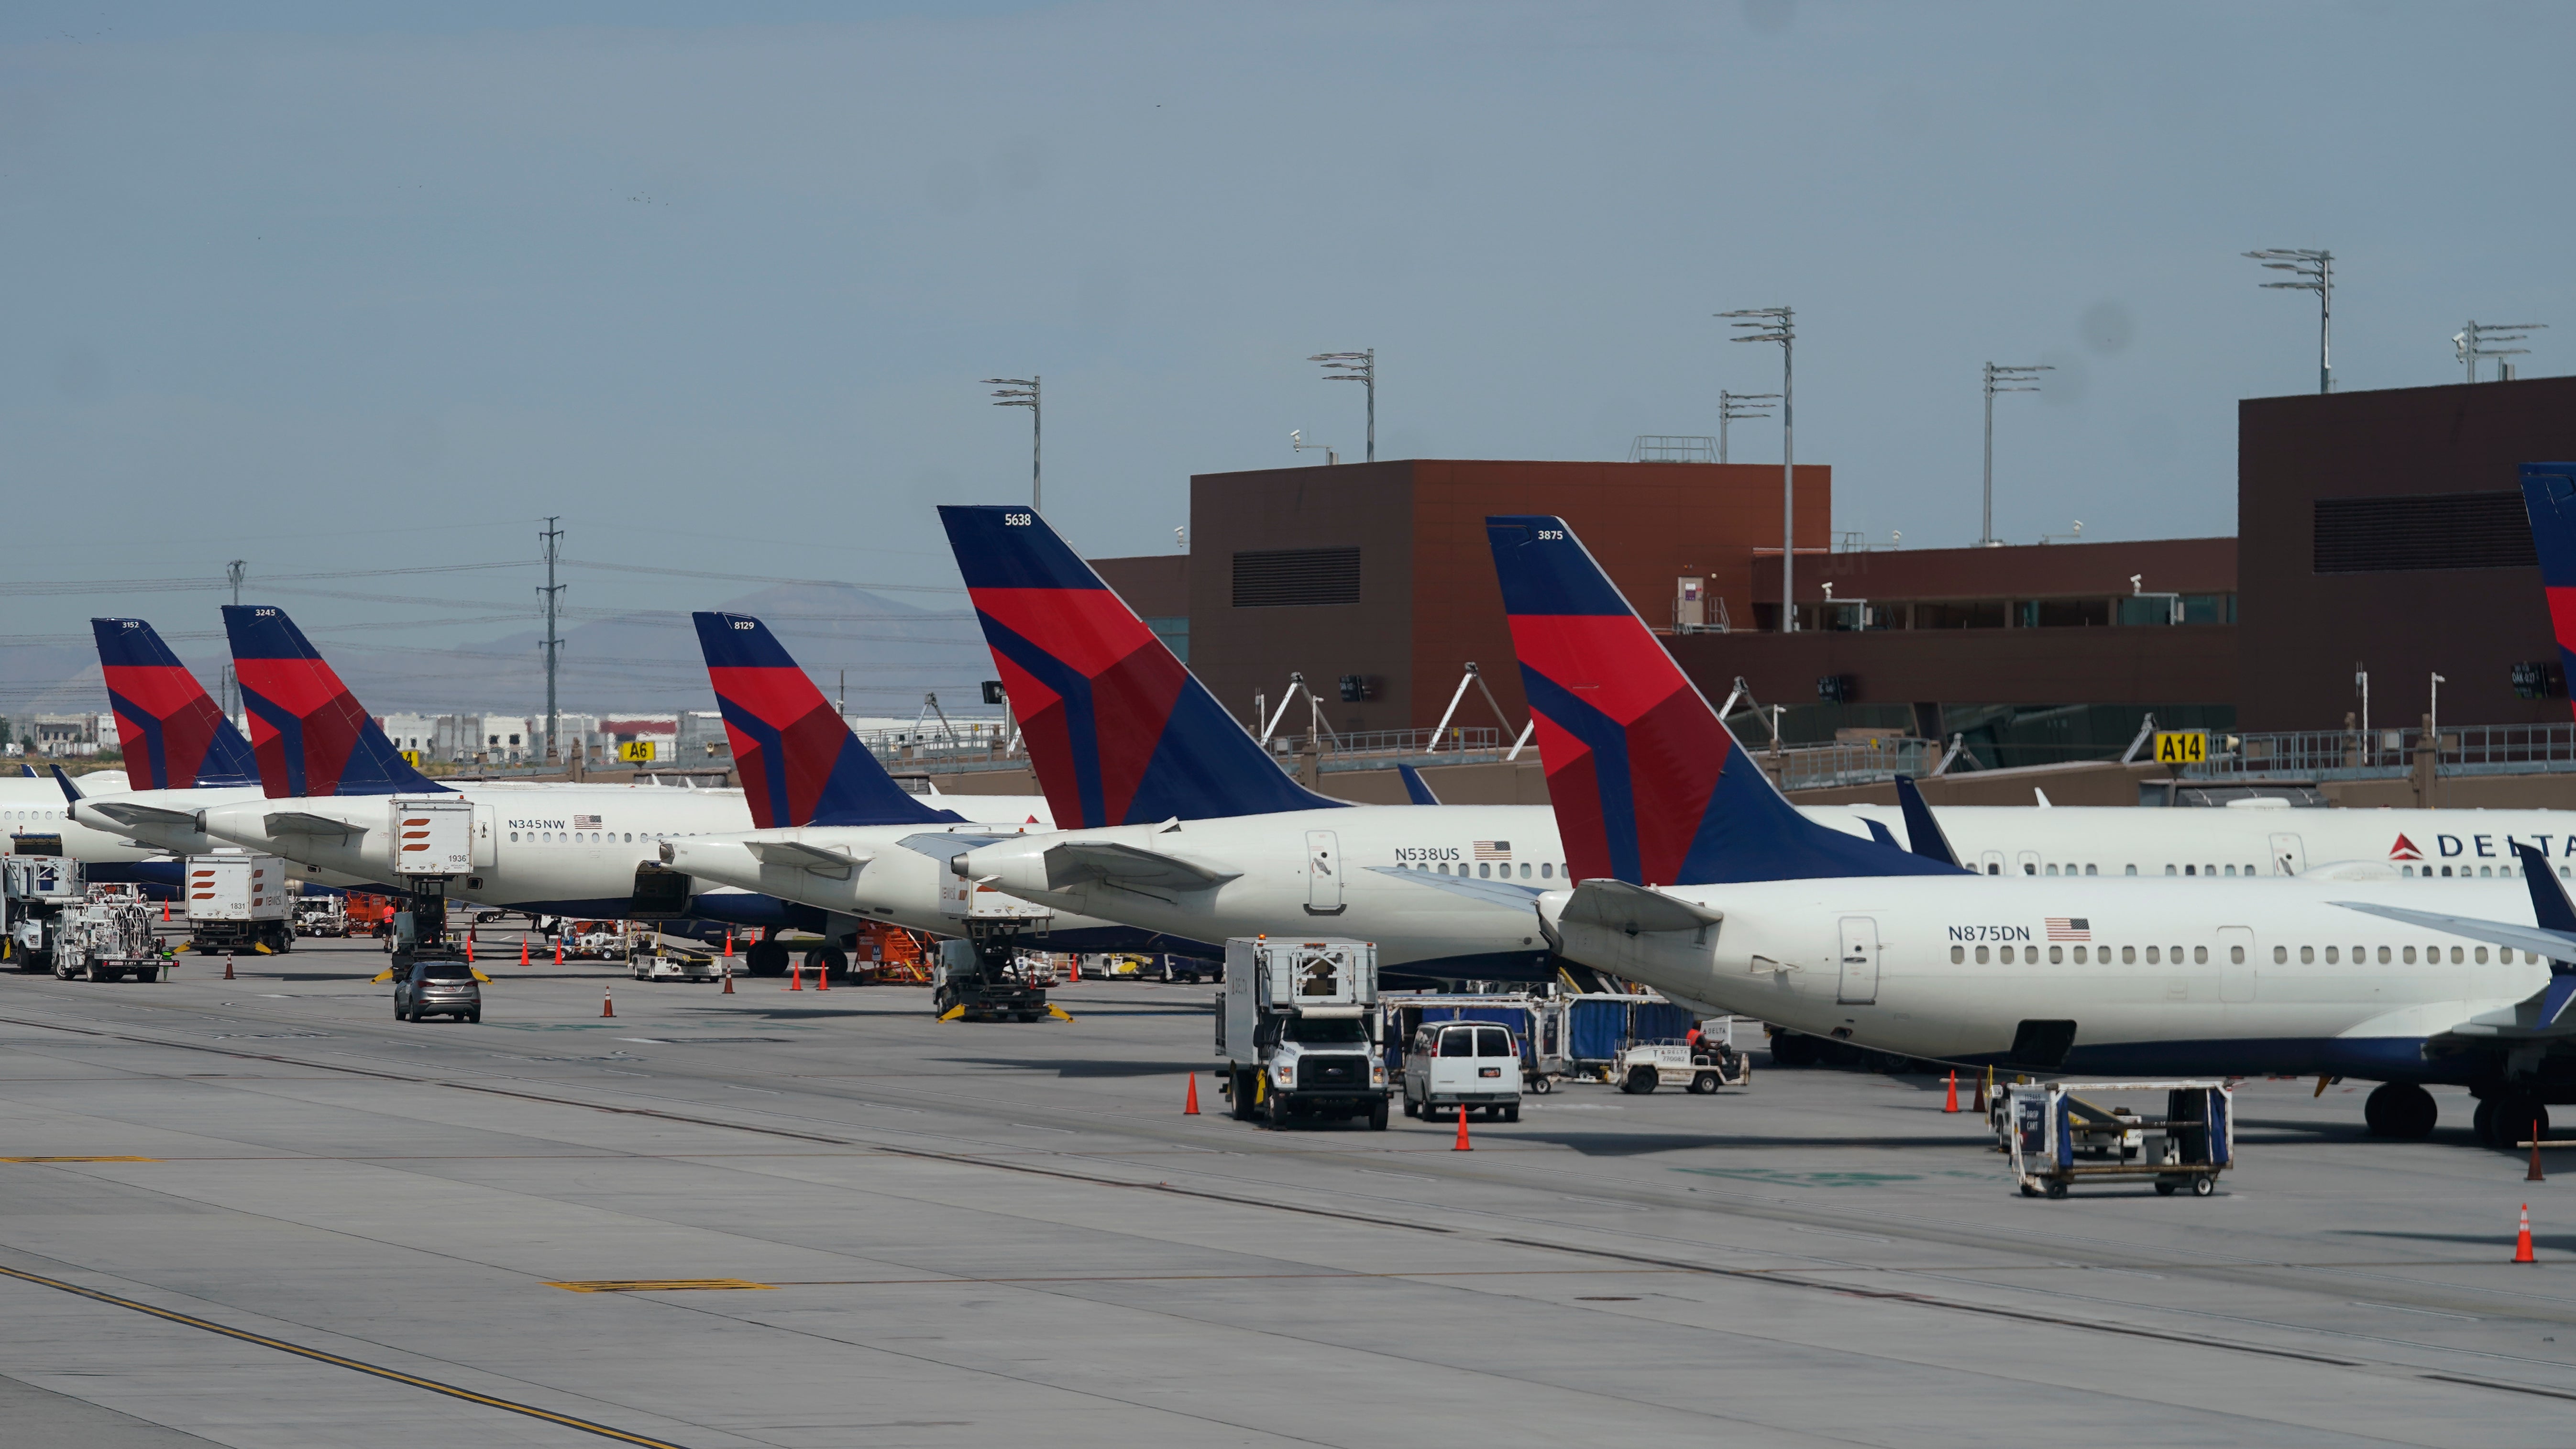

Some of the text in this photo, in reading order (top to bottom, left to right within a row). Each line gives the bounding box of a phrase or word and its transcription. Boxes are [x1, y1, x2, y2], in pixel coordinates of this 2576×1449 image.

[1005, 513, 1031, 526] 5638
[1538, 531, 1563, 540] 3875
[734, 621, 754, 630] 8129
[629, 742, 647, 758] A6
[2162, 734, 2201, 760] A14
[508, 819, 566, 829] N345NW
[1395, 848, 1460, 861] N538US
[1949, 926, 2030, 941] N875DN
[2026, 1110, 2038, 1119] DROP
[2026, 1121, 2038, 1131] CART
